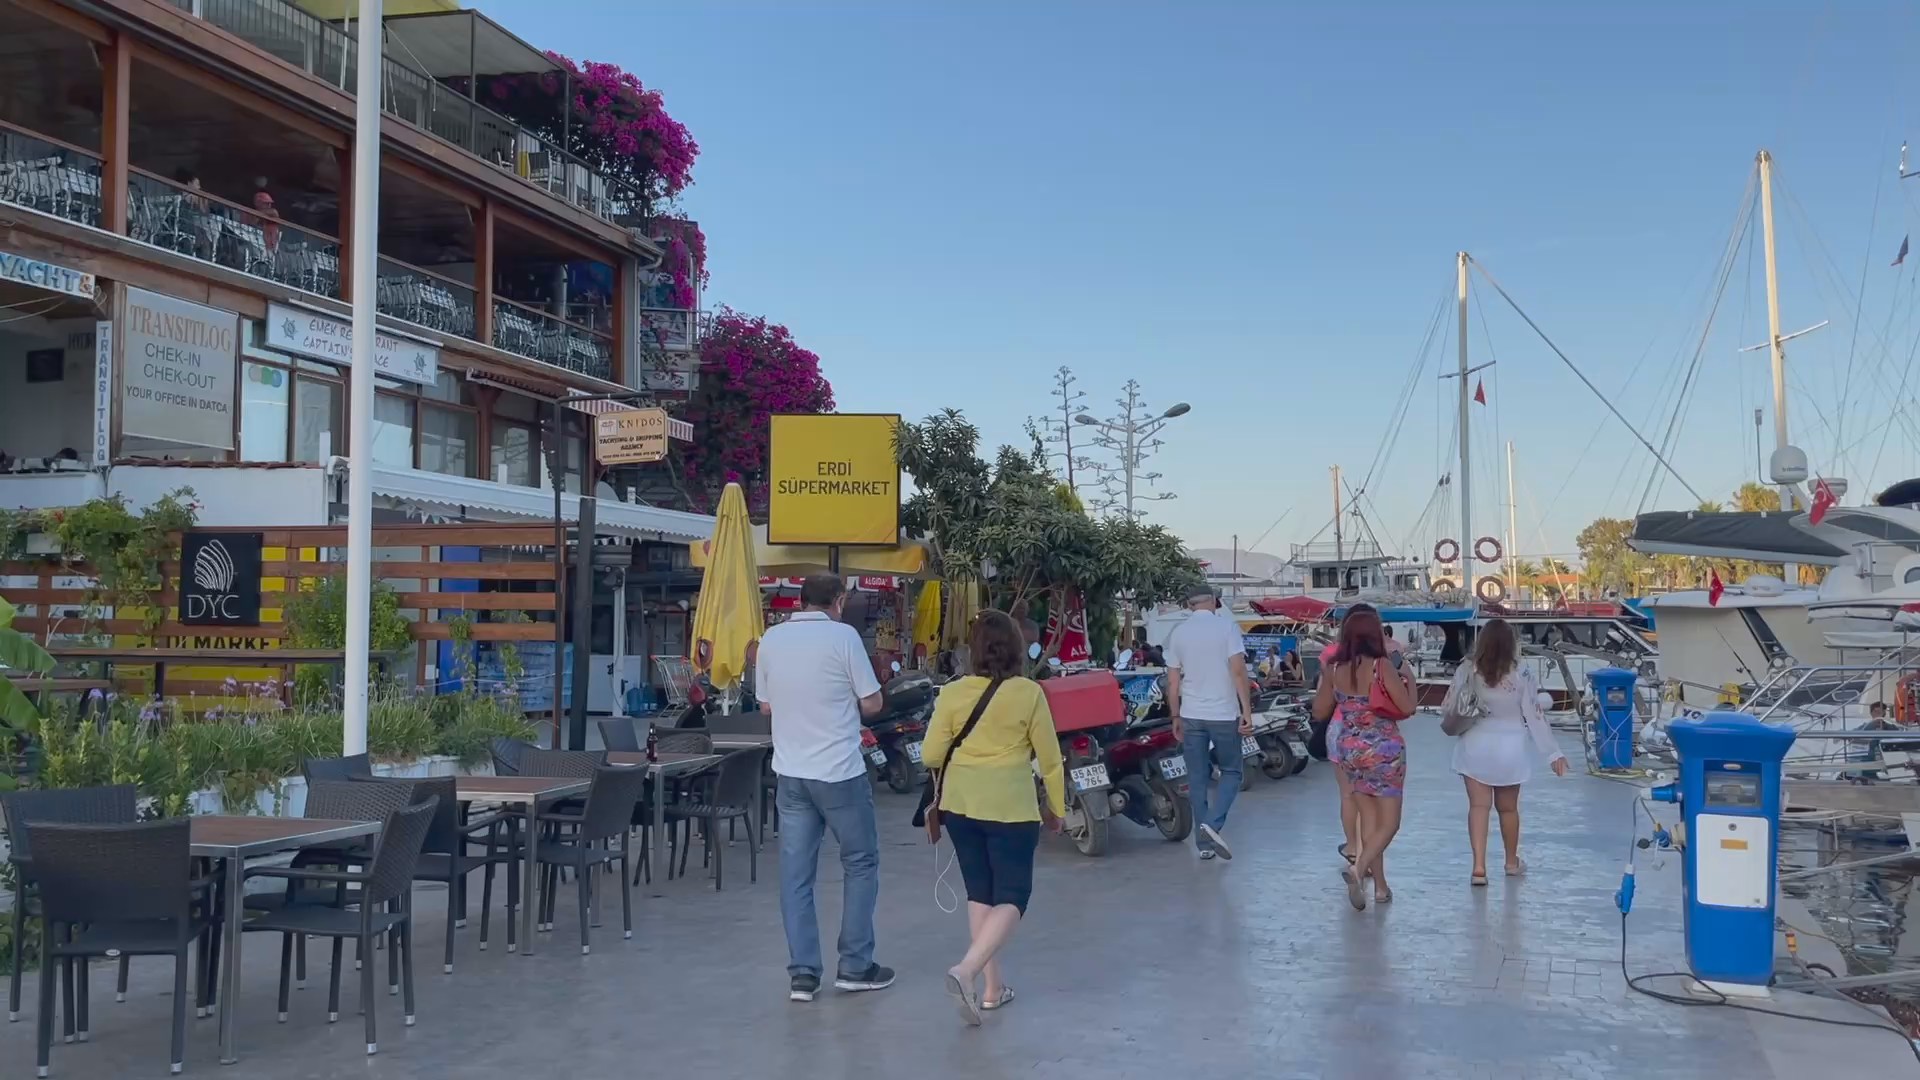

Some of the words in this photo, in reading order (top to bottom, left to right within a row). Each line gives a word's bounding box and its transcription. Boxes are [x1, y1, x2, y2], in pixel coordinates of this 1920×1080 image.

[130, 304, 232, 352] TRANSITLOG
[309, 319, 337, 336] EMEK
[145, 342, 201, 368] CHEK-IN
[143, 363, 217, 390] CHEK-OUT
[97, 326, 109, 461] TRANSITLOG
[126, 385, 153, 400] YOUR
[154, 390, 187, 407] OFFICE
[188, 396, 198, 408] IN
[199, 398, 228, 414] DATCA
[619, 417, 662, 429] KNIDOS
[817, 459, 852, 476] ERDİ
[778, 477, 890, 495] SÜPERMARKET
[865, 576, 888, 586] ALGIDA
[186, 594, 241, 619] DYC
[1072, 768, 1085, 780] 35
[1086, 765, 1106, 777] ARD
